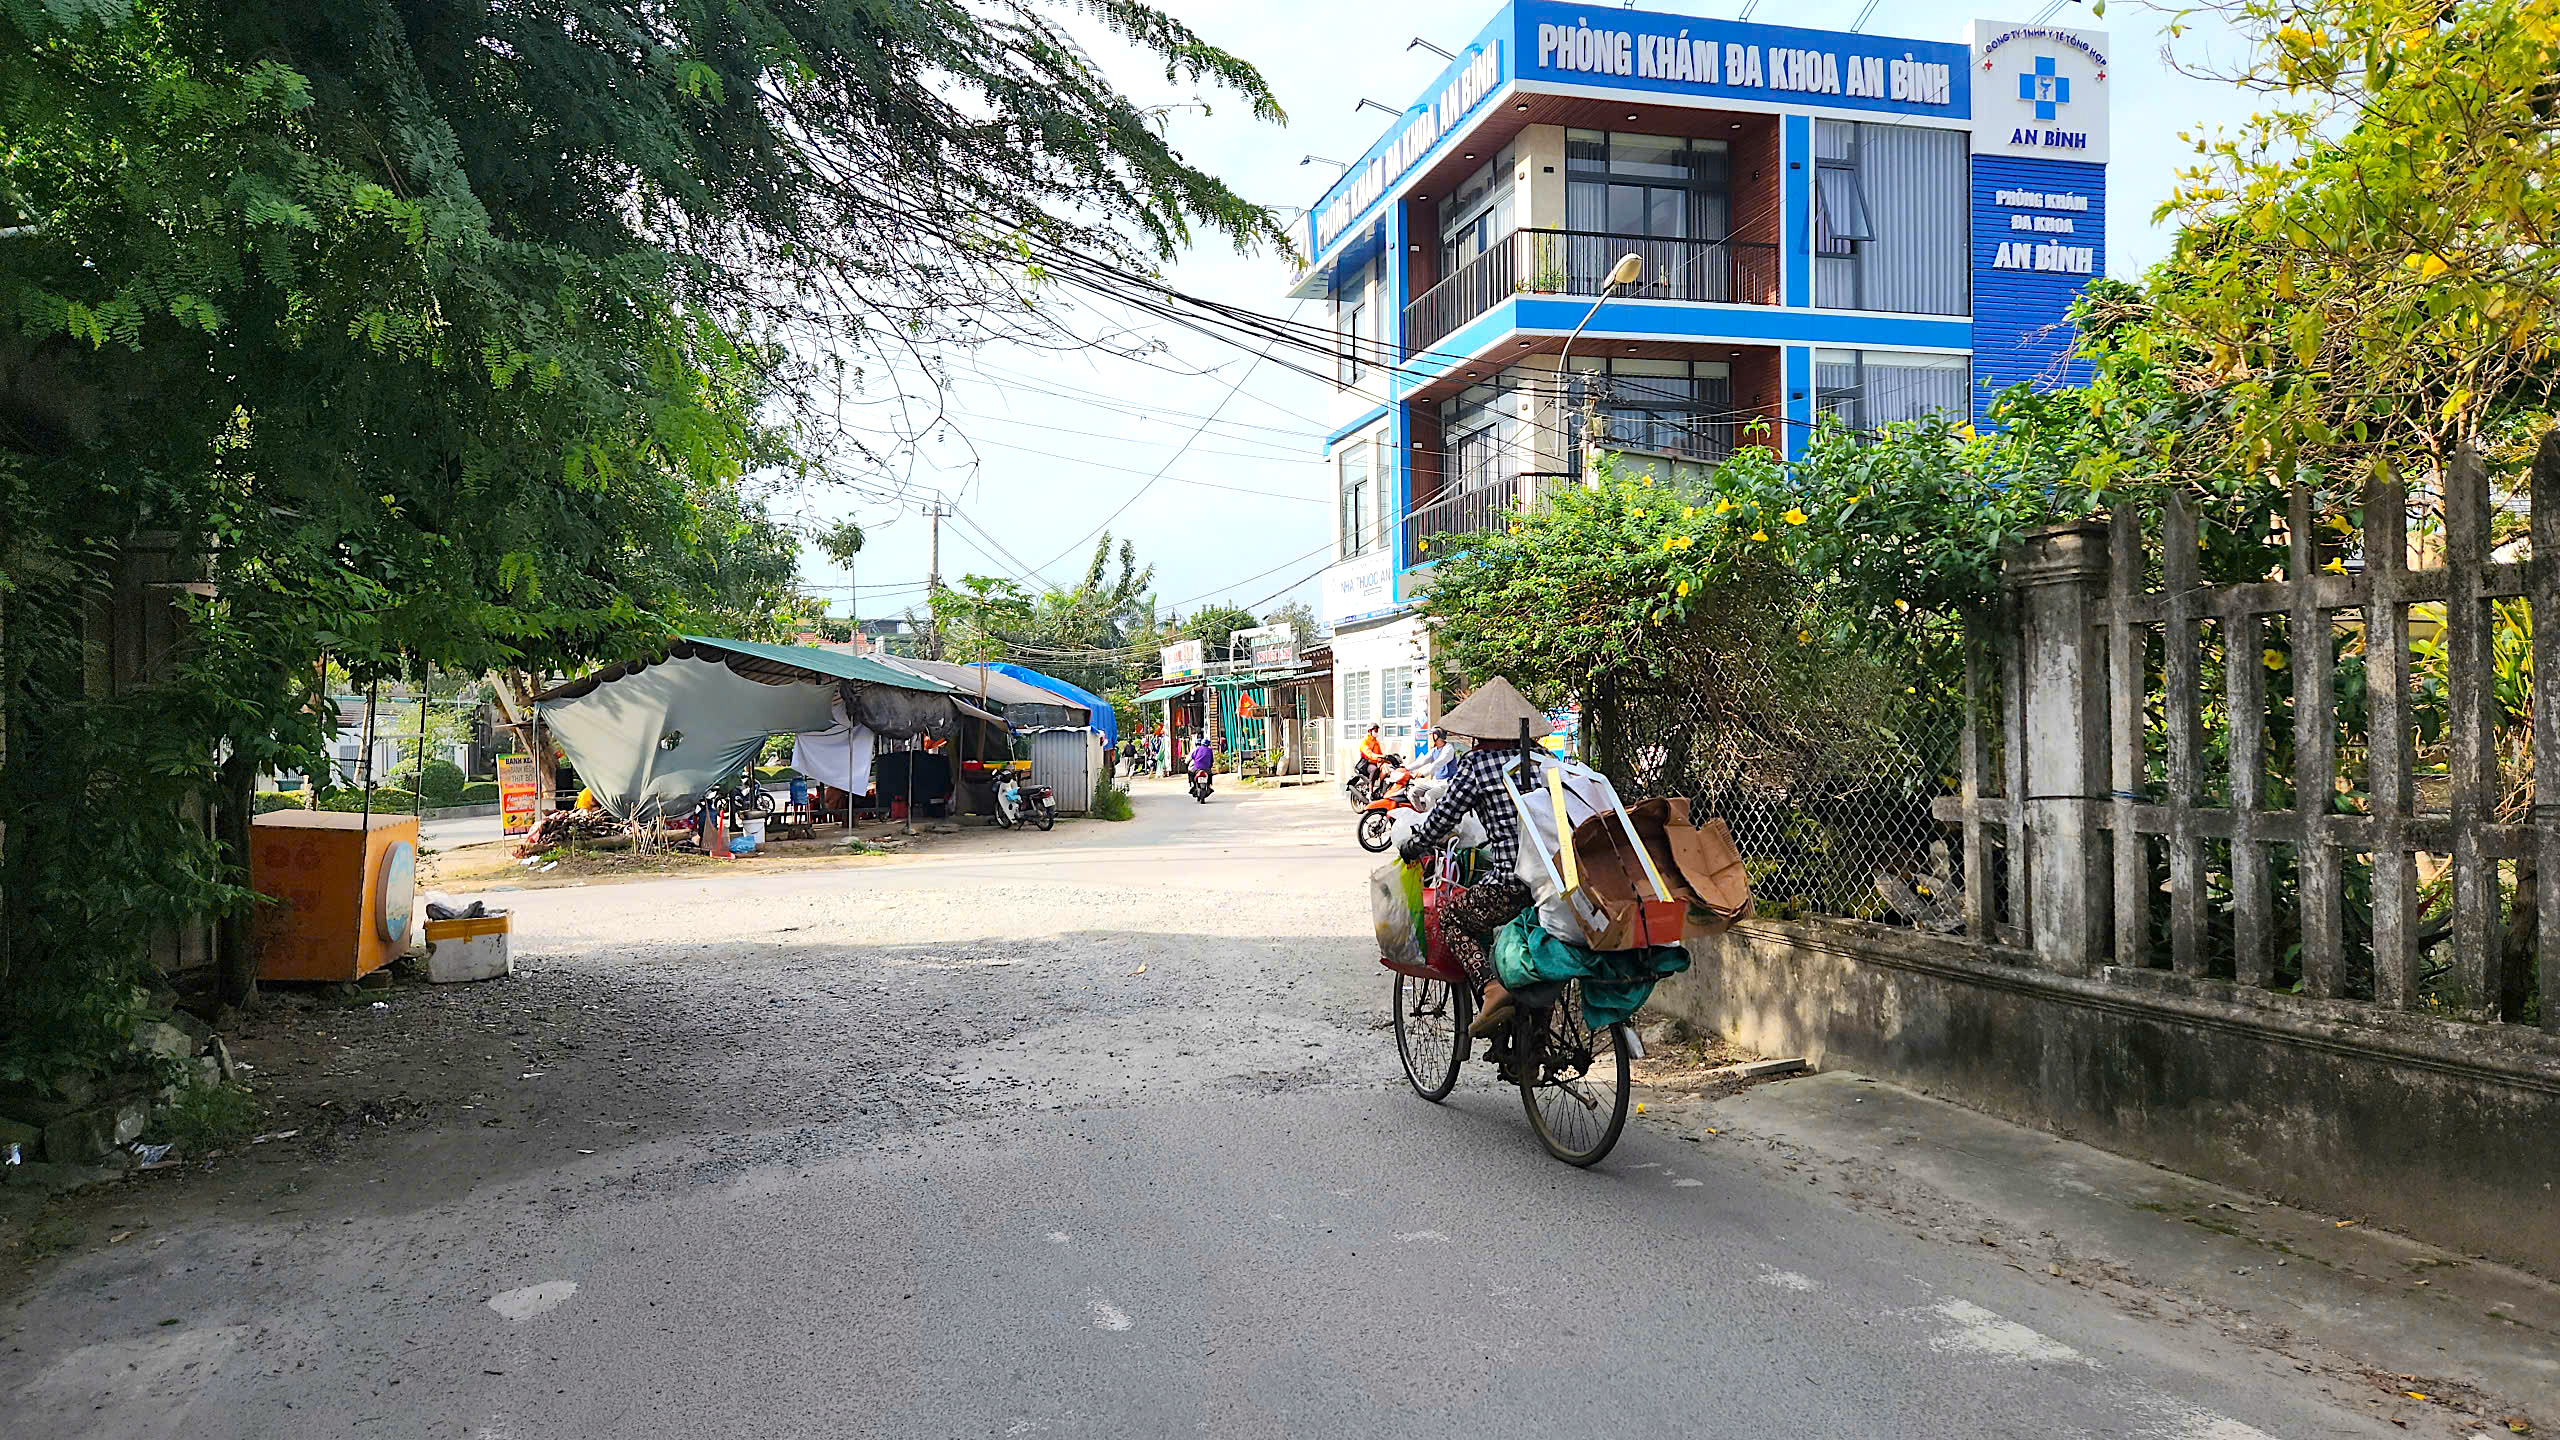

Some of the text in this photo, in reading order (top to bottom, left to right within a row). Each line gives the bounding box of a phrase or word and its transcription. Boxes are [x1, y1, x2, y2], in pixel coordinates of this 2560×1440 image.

[2023, 28, 2046, 38] TNHH
[1538, 16, 1950, 105] PHÒNG KHÁM ĐA KHOA AN BÌNH
[1402, 103, 1438, 173] KHOA
[1439, 76, 1461, 137] AN
[1461, 39, 1499, 113] BÌNH
[2010, 127, 2087, 149] AN BÌNH
[1995, 187, 2088, 211] PHÒNG KHÁM
[2011, 214, 2074, 233] ĐA KHOA
[1992, 238, 2094, 274] AN BÌNH
